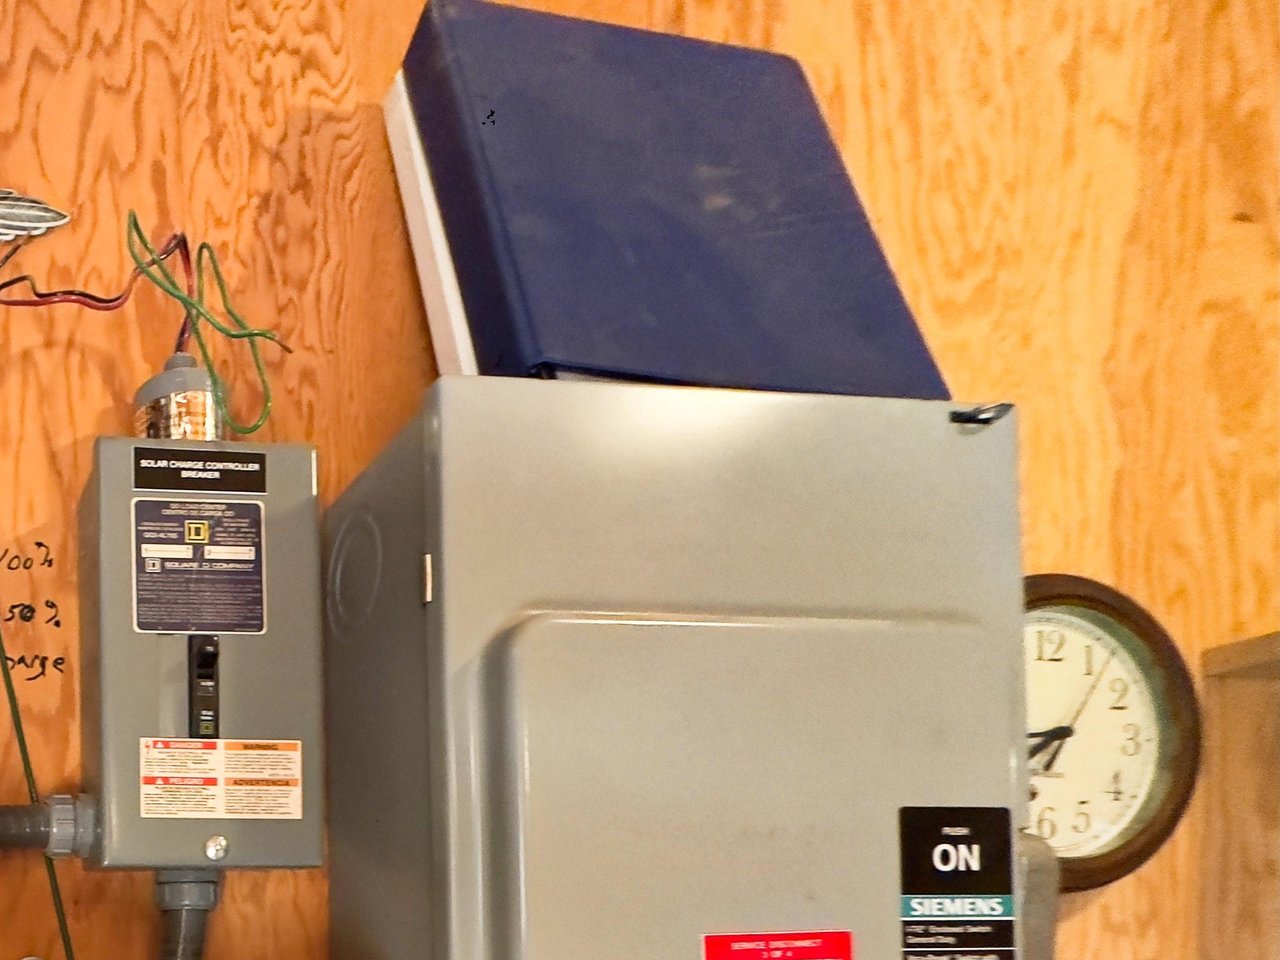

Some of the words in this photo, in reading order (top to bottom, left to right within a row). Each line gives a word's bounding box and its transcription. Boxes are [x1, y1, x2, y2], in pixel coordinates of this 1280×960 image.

[140, 459, 169, 468] SOLAR
[169, 460, 204, 470] CHARGE
[205, 461, 261, 472] CONTROLLER
[181, 470, 221, 480] BREAKER
[211, 562, 256, 570] COMPANY
[1034, 630, 1066, 662] 12
[1083, 644, 1094, 676] 1
[1109, 677, 1130, 710] 2
[1121, 723, 1141, 757] 3
[1036, 806, 1058, 840] 6
[1071, 799, 1092, 834] 5
[932, 843, 982, 872] ON
[910, 897, 1004, 917] SIEMENS
